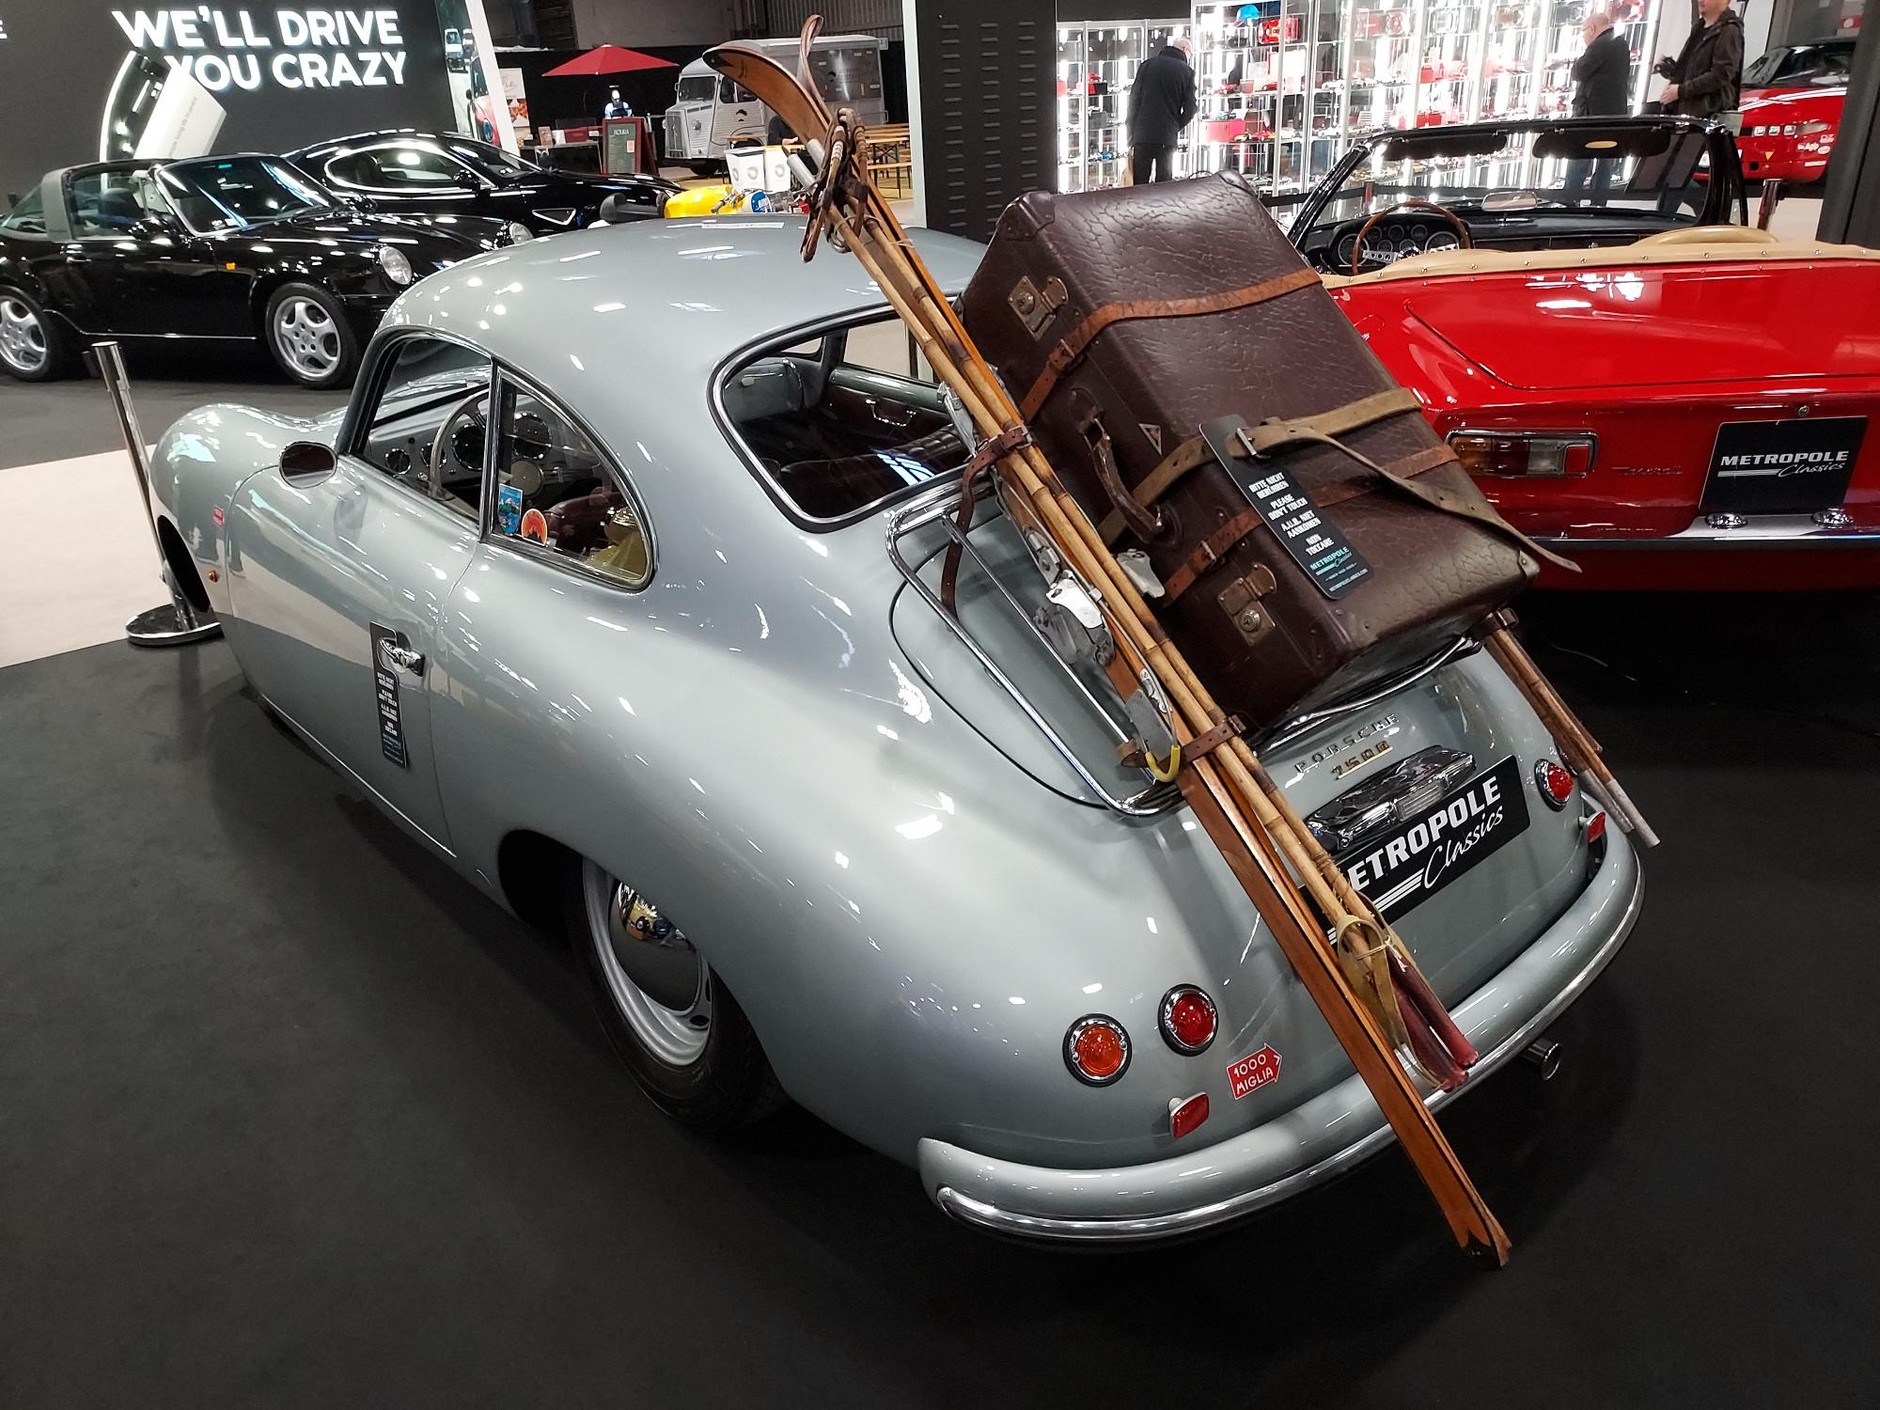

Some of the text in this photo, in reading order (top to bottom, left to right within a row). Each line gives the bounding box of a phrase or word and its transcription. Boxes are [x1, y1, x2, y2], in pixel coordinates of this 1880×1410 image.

[111, 5, 403, 47] WE'LL DRIVE
[272, 51, 406, 87] CRAZY
[1720, 450, 1849, 466] METROPOLE
[1778, 462, 1846, 477] Classics
[1248, 472, 1285, 493] BITTE NICHT
[1267, 497, 1308, 520] DON'T TOUCH
[1270, 493, 1295, 509] PLEASE
[1305, 533, 1322, 545] NON
[1305, 537, 1335, 556] TOCCARE
[1309, 546, 1350, 570] METROPOLE
[1294, 713, 1399, 773] PORSCHE
[1331, 740, 1393, 780] 1500
[1346, 775, 1501, 892] ETROPOLE
[1424, 805, 1504, 890] Classics
[1233, 1054, 1266, 1078] 1000
[1236, 1066, 1274, 1095] MIGLIA
